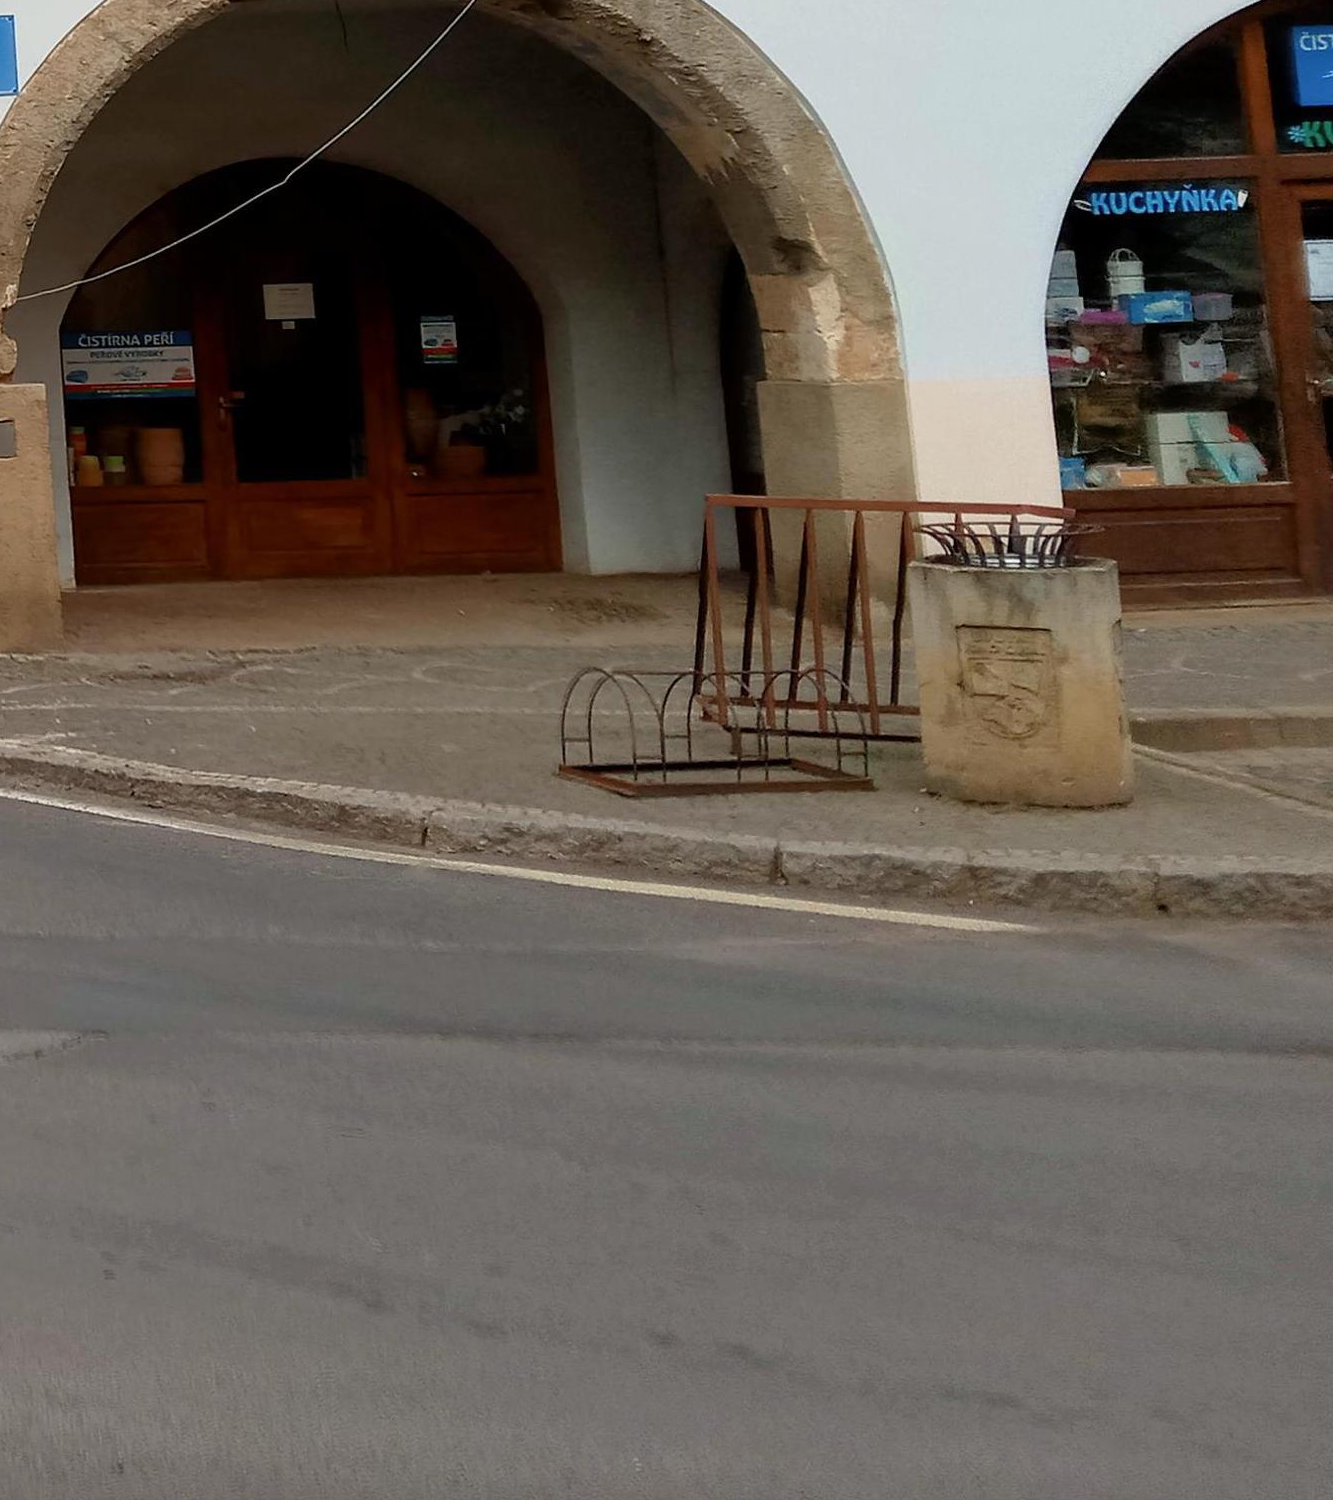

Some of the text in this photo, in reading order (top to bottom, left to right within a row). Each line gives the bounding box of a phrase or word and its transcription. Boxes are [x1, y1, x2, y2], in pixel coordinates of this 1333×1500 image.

[1091, 184, 1238, 215] KUCHYŇKA
[78, 331, 175, 348] ČISTÍRNA PEŘÍ
